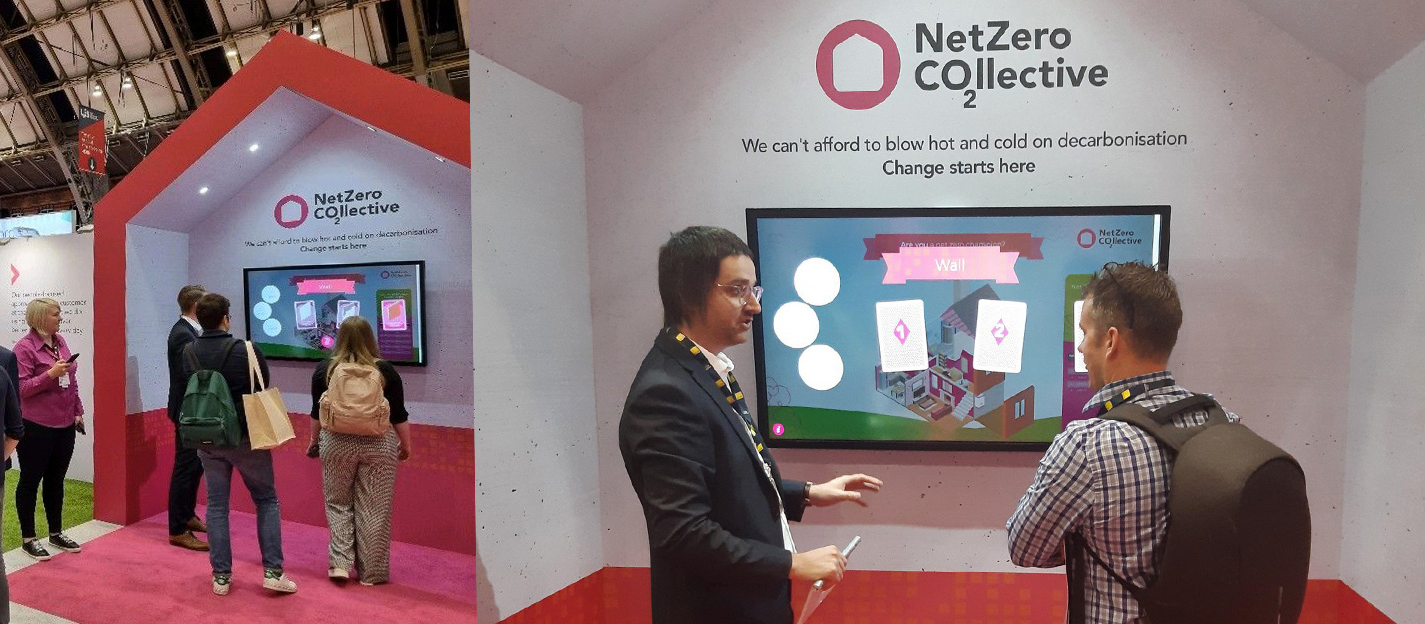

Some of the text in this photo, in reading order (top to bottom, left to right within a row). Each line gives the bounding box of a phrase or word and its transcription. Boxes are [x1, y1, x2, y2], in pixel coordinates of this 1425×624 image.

[915, 20, 1072, 53] NetZero
[742, 131, 1187, 153] We can't afford to blow hot and cold on decarbonisation
[882, 158, 1035, 179] Change starts here
[314, 189, 382, 206] NetZero
[1099, 228, 1134, 237] NetZero
[935, 258, 965, 272] Wall
[896, 324, 906, 340] 1
[993, 322, 1005, 339] 2
